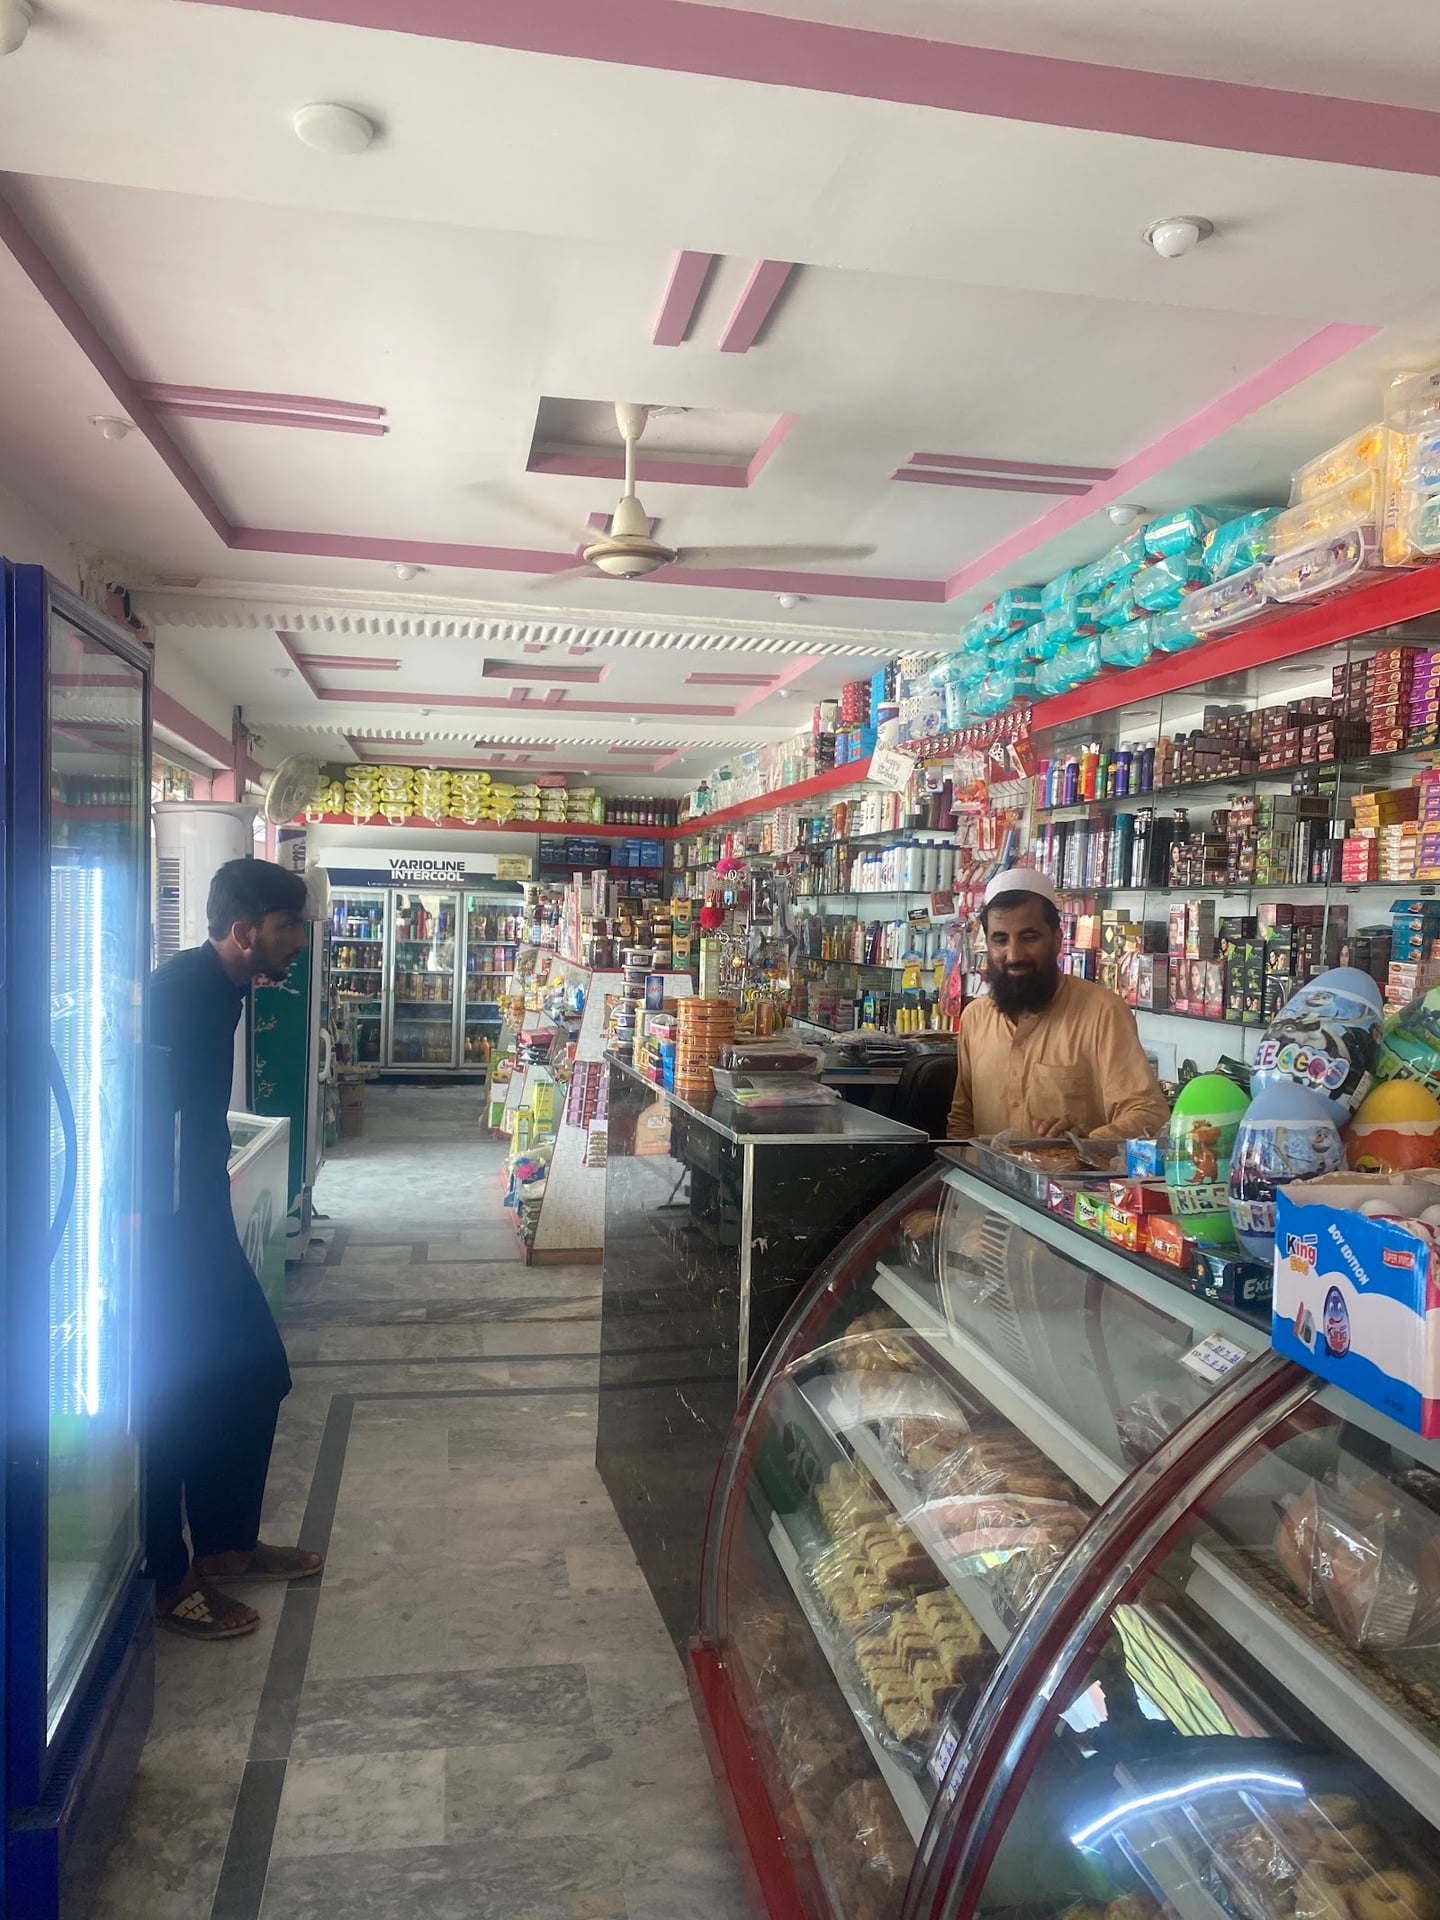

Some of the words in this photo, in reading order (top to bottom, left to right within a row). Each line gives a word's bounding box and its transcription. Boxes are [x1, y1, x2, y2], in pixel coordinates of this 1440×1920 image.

[389, 859, 465, 871] VARIOLINE
[391, 870, 465, 882] INTERCOOL
[1286, 1233, 1317, 1267] King
[1327, 1223, 1345, 1245] BOY
[1340, 1243, 1370, 1286] EDITION
